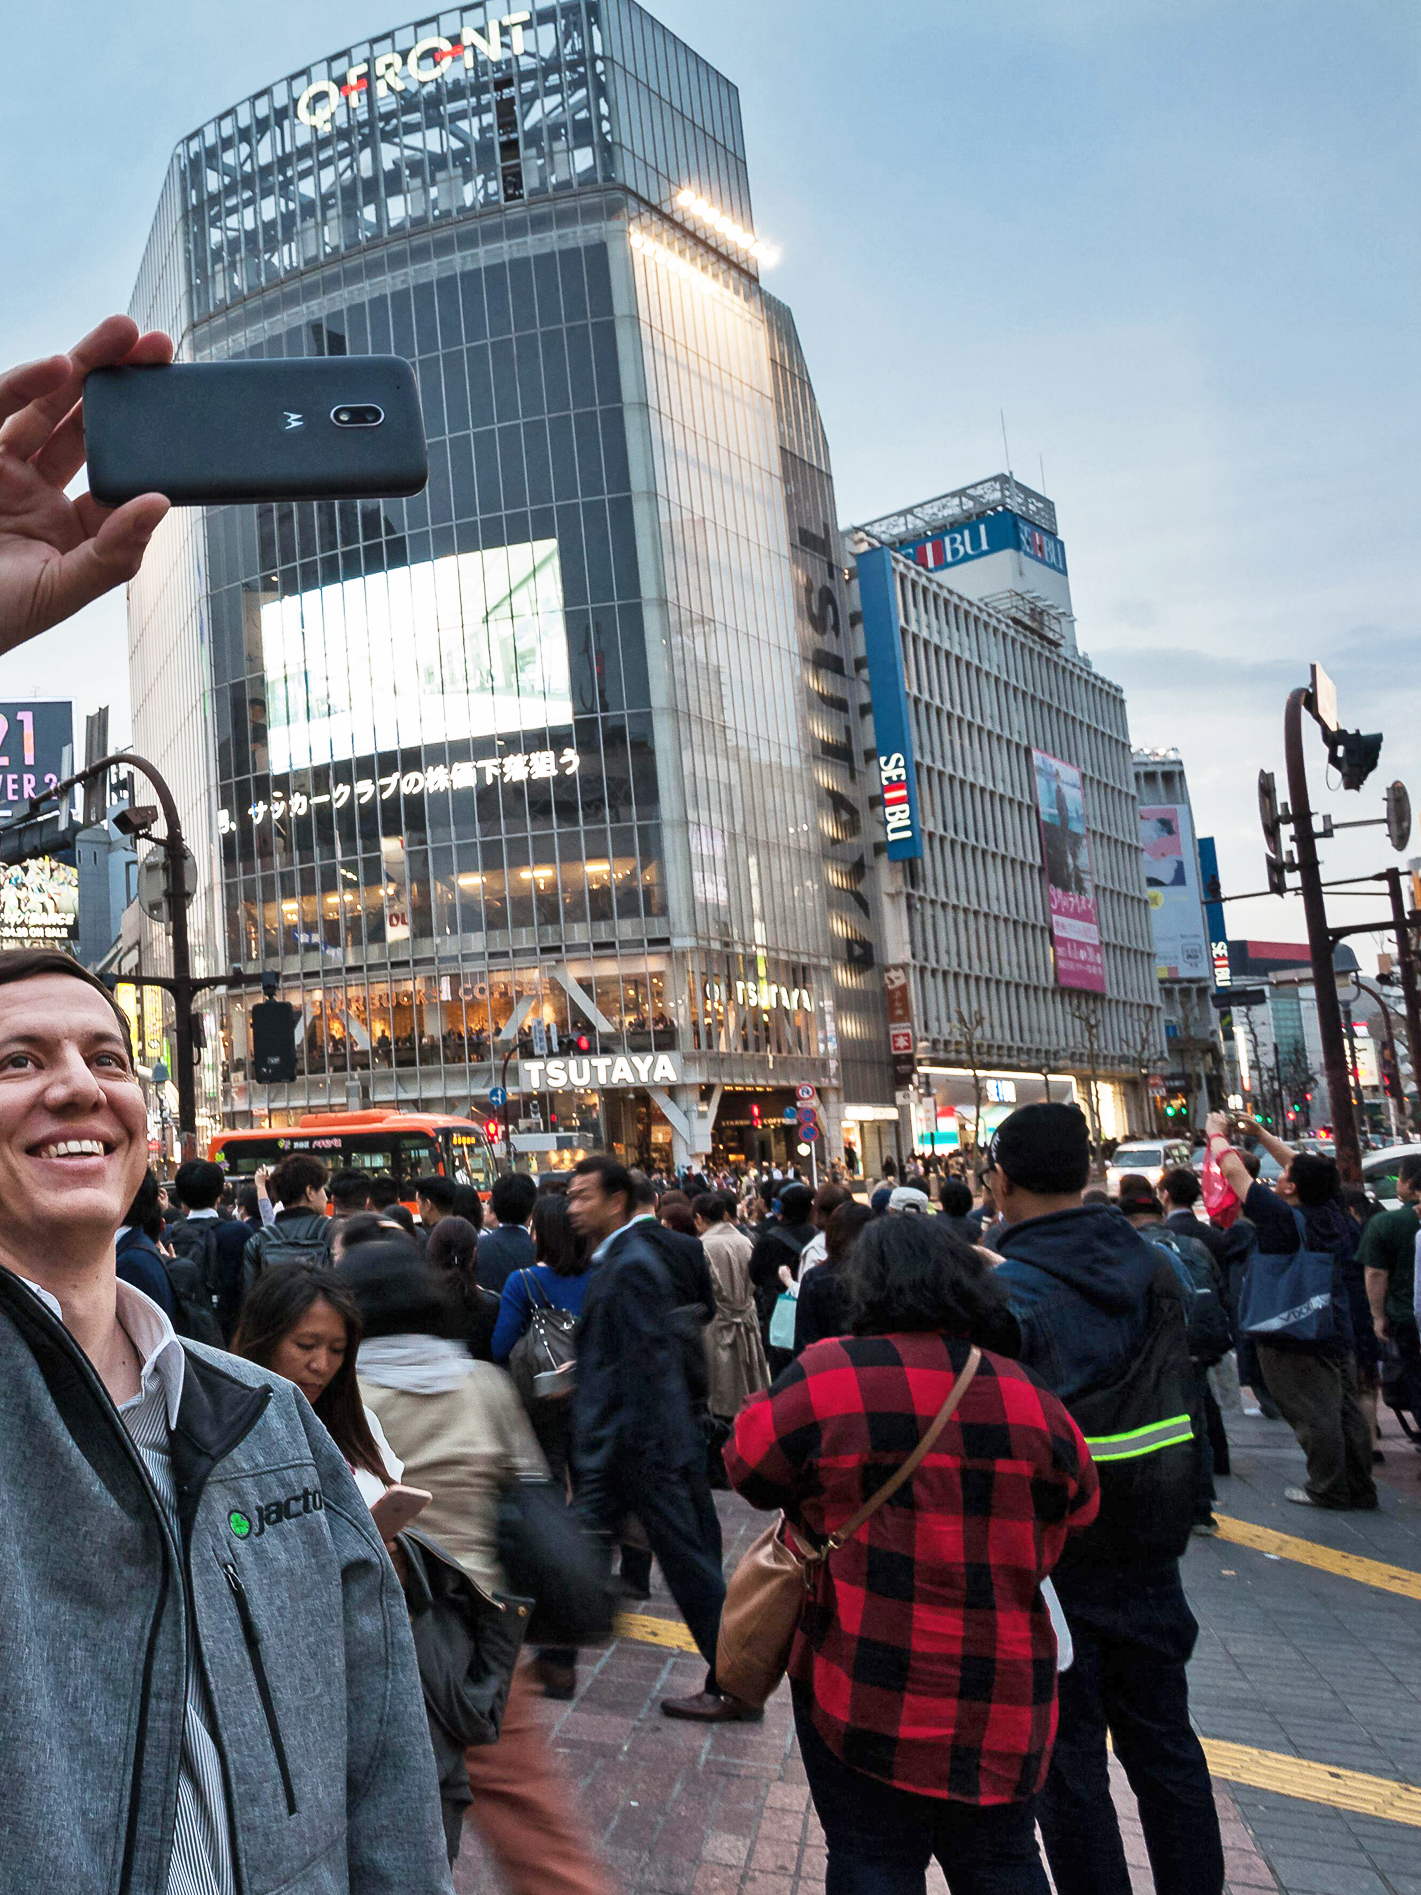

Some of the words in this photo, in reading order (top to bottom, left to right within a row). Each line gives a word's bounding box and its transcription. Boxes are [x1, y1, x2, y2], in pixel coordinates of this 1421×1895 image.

[297, 10, 530, 133] QFRONT
[880, 752, 913, 843] SEIBU
[1212, 941, 1232, 987] SEIBU
[523, 1054, 678, 1089] TSUTAYA
[254, 1487, 323, 1538] jacto
